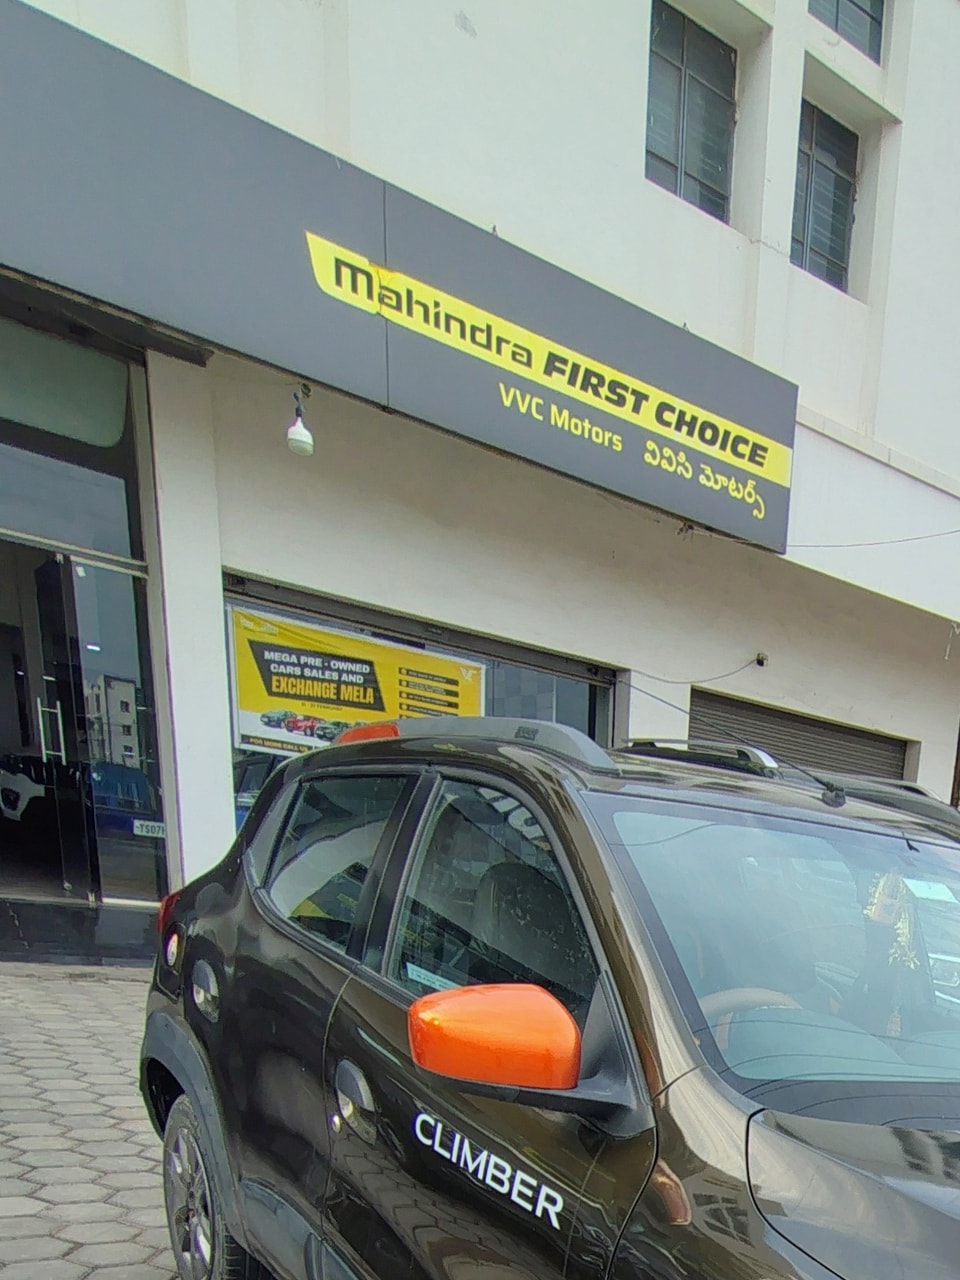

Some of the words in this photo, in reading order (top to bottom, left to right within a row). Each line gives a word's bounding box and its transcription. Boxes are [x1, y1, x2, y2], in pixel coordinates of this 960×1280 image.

[334, 256, 533, 369] mahindra
[543, 351, 650, 415] FIRST
[654, 401, 770, 468] CHOICE
[498, 381, 545, 422] VVC
[549, 402, 623, 452] Motors
[263, 650, 298, 663] MEGA
[300, 655, 323, 667] PRE
[330, 660, 370, 673] OWNED
[270, 663, 301, 675] CARS
[303, 668, 339, 680] SALES
[340, 673, 364, 684] AND
[271, 675, 337, 699] EXCHANGE
[339, 684, 374, 704] MELA
[414, 1112, 564, 1231] CLIMBER
